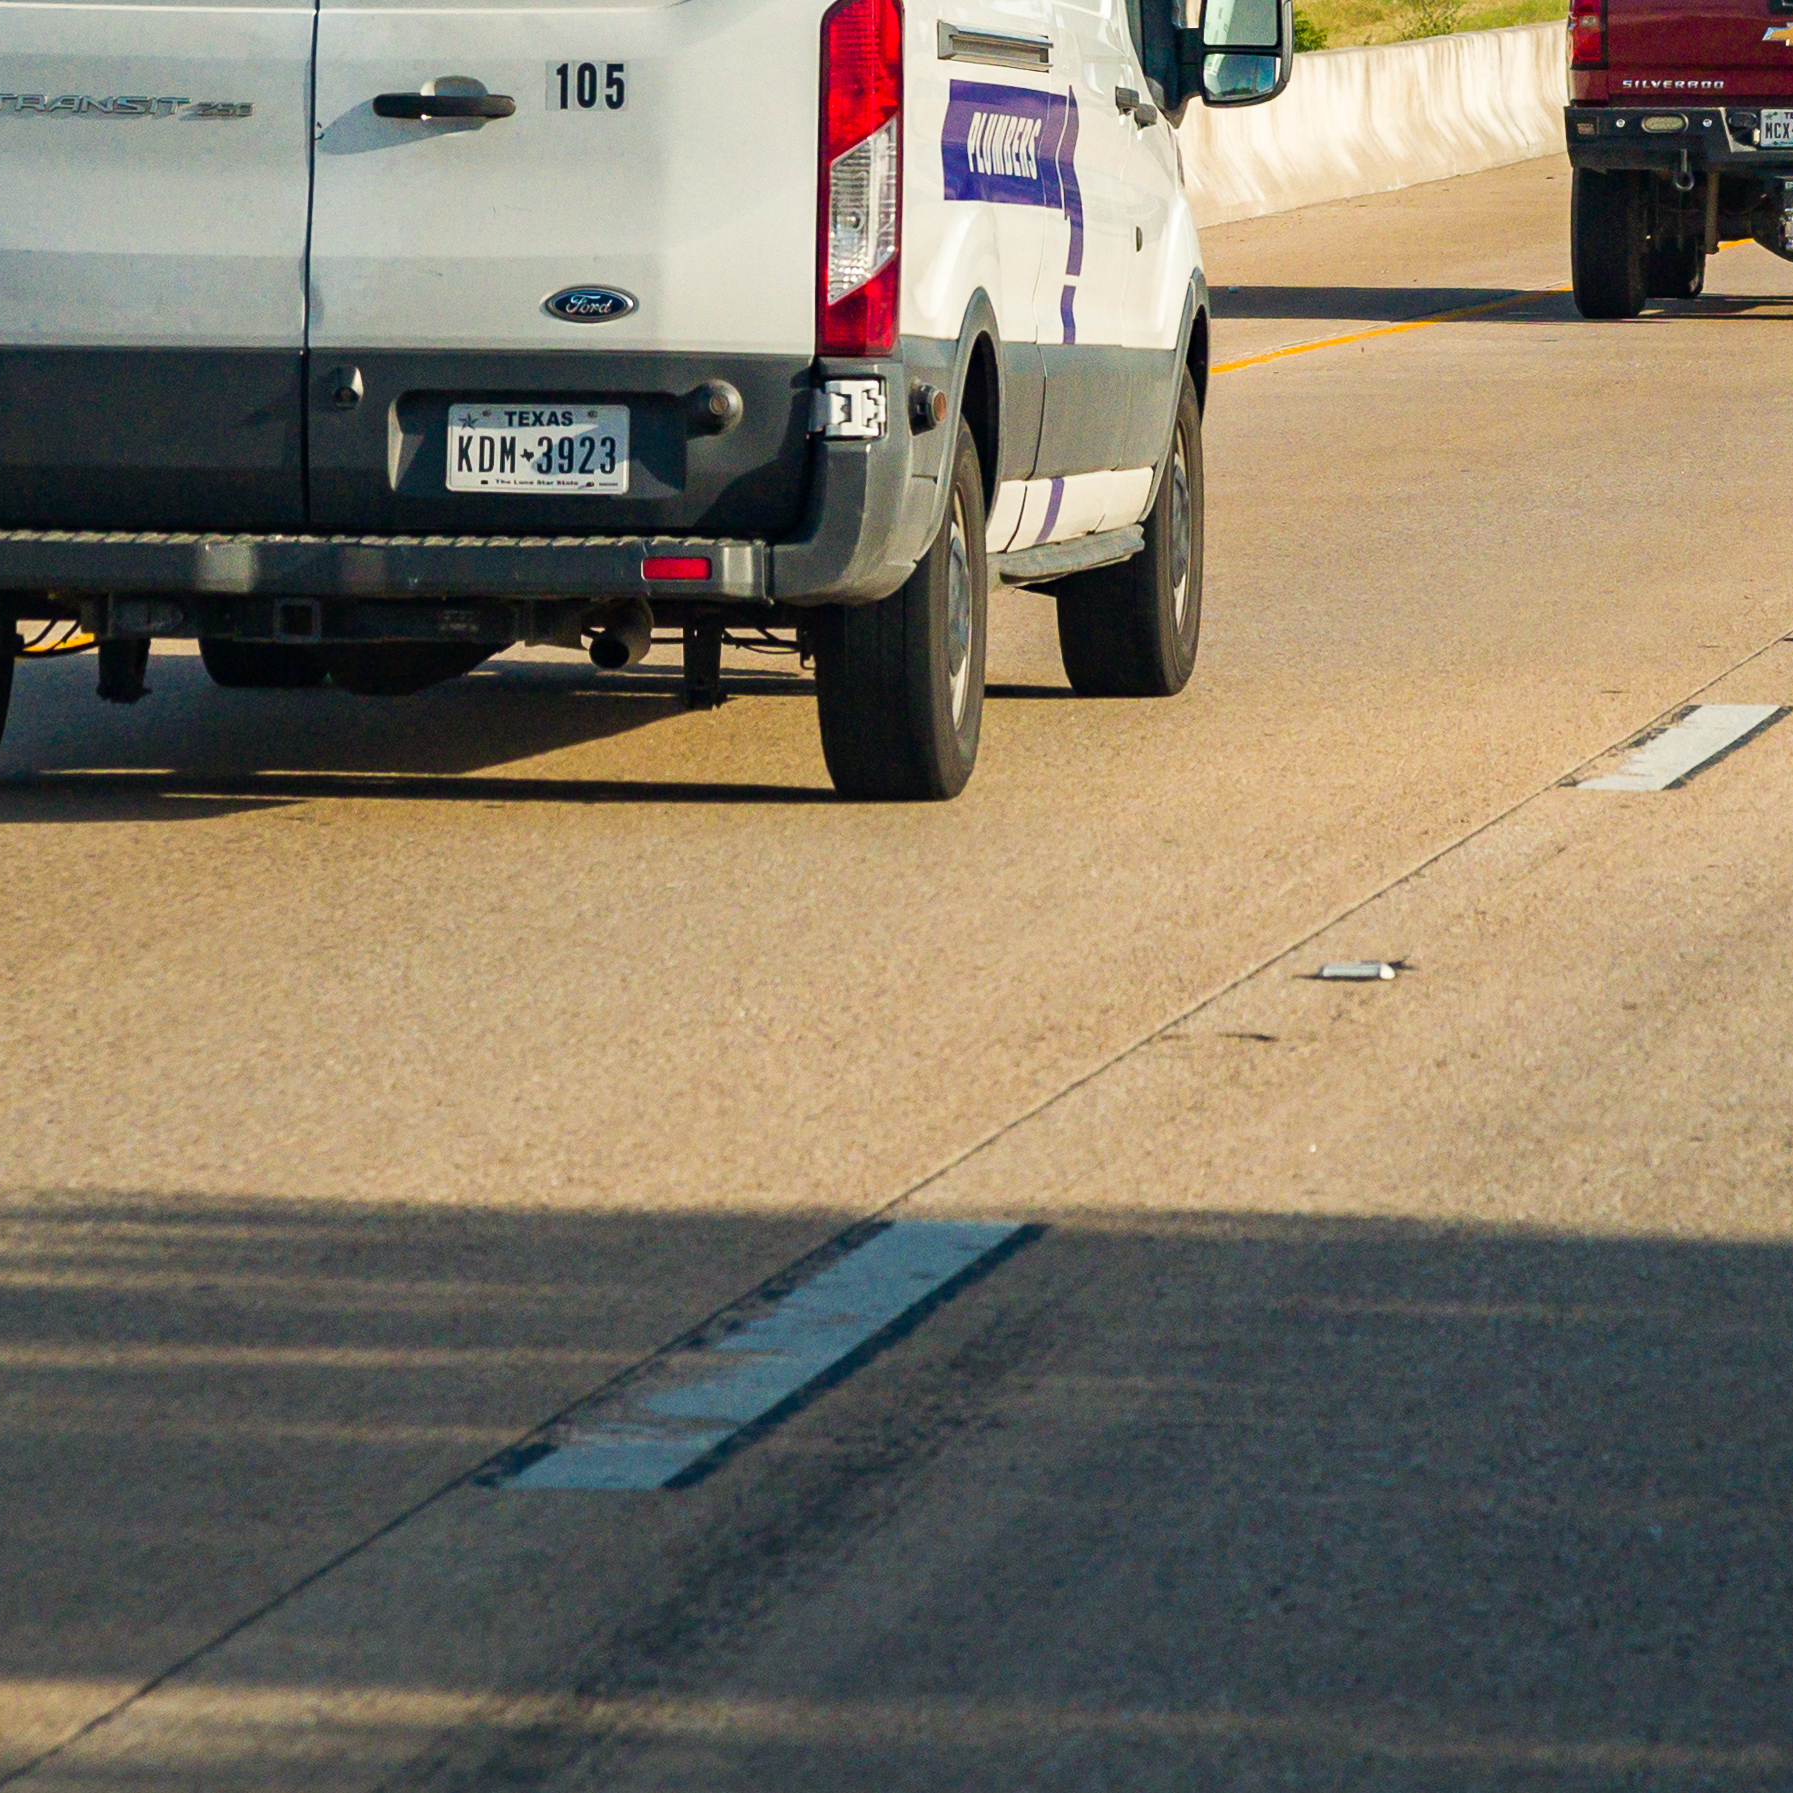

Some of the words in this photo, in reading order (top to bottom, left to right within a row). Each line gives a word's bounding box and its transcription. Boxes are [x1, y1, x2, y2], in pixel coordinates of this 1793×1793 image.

[556, 62, 625, 110] 105
[1622, 80, 1724, 88] SILVERADO
[967, 112, 1042, 180] PLUMBERS
[566, 295, 613, 314] Ford
[504, 411, 573, 427] TEXAS
